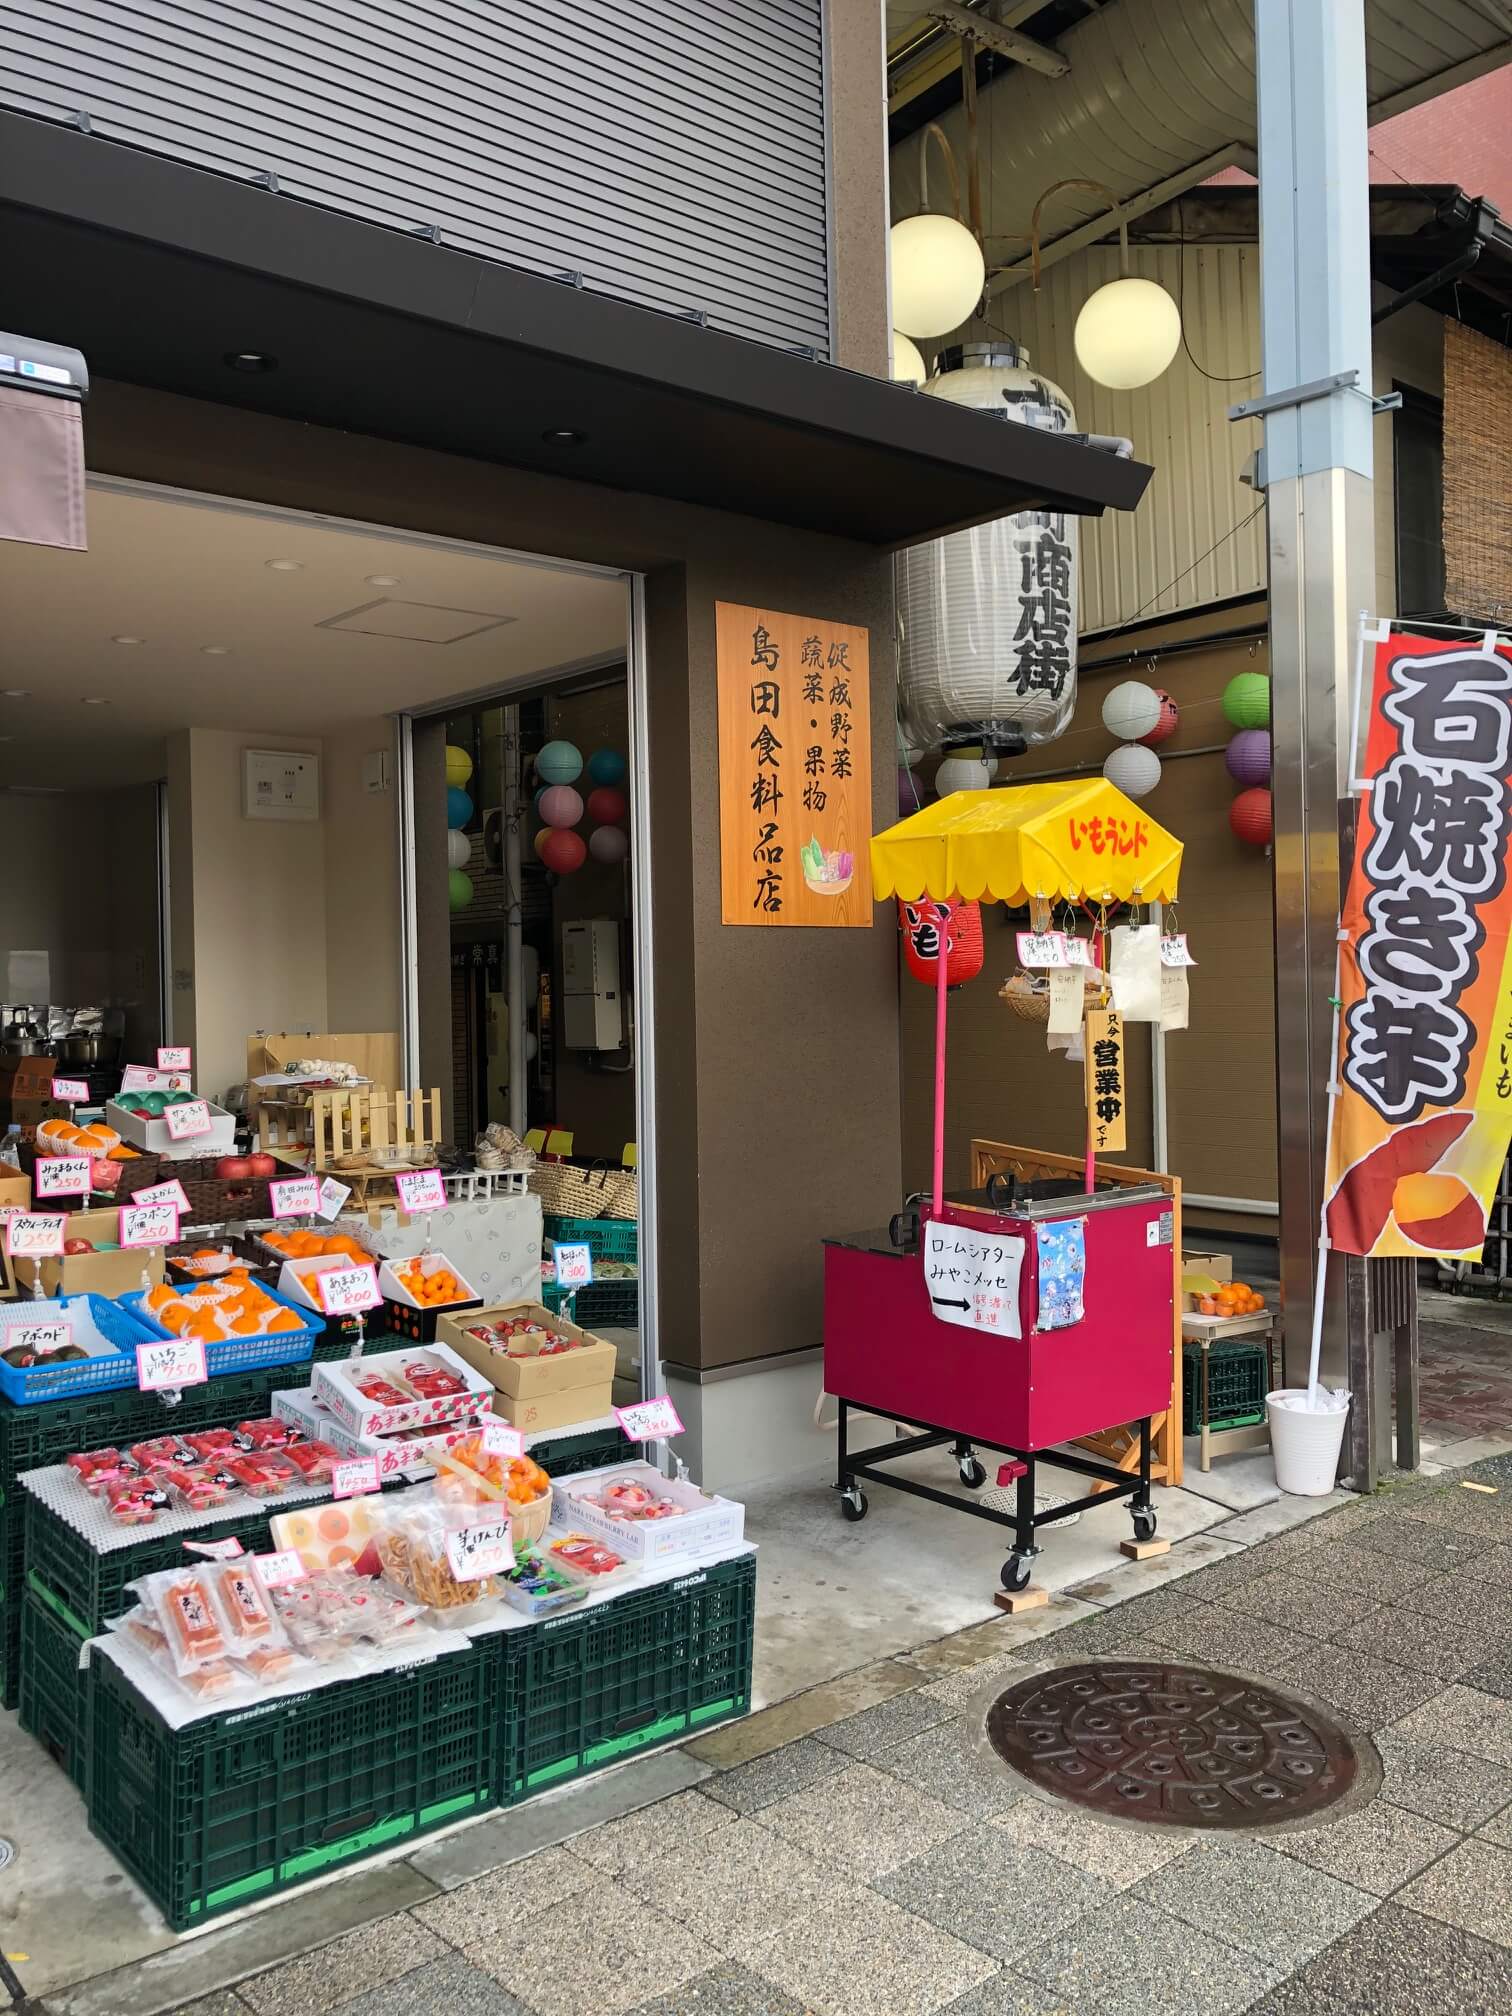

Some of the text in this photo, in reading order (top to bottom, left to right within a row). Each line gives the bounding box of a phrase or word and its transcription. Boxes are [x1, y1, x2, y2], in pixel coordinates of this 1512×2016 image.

[827, 641, 852, 779] 促成野菜
[750, 625, 784, 912] 島田食料品店
[1348, 652, 1510, 1115] 石焼き芋
[129, 1207, 172, 1223] デコポン
[932, 1240, 1014, 1263] ロームシアター
[930, 1265, 1007, 1288] みやこメッセ
[974, 1309, 999, 1326] 直進
[18, 1326, 65, 1343] アボカド
[150, 1340, 193, 1363] いちご
